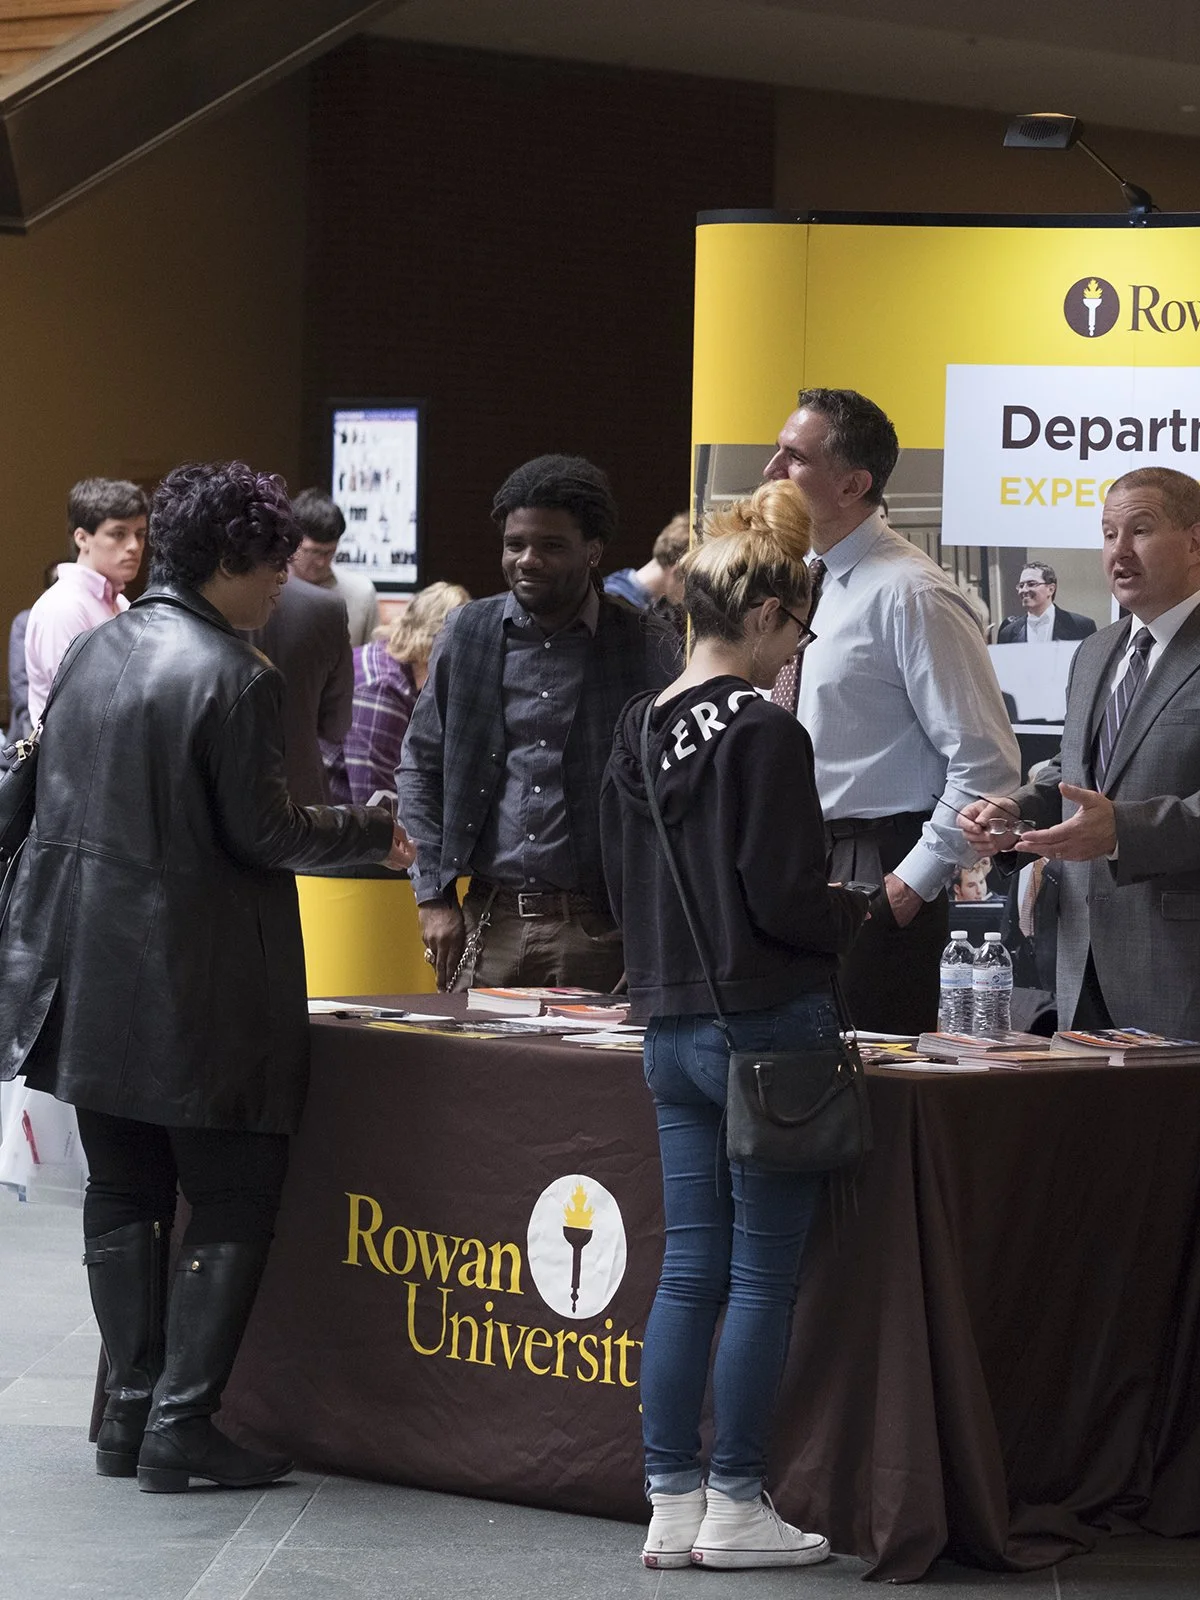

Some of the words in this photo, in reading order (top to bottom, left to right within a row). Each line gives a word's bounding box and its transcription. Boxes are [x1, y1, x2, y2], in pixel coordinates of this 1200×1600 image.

[1000, 476, 1119, 508] EXPEC
[342, 1191, 525, 1295] Rowan
[403, 1280, 644, 1413] Universit
